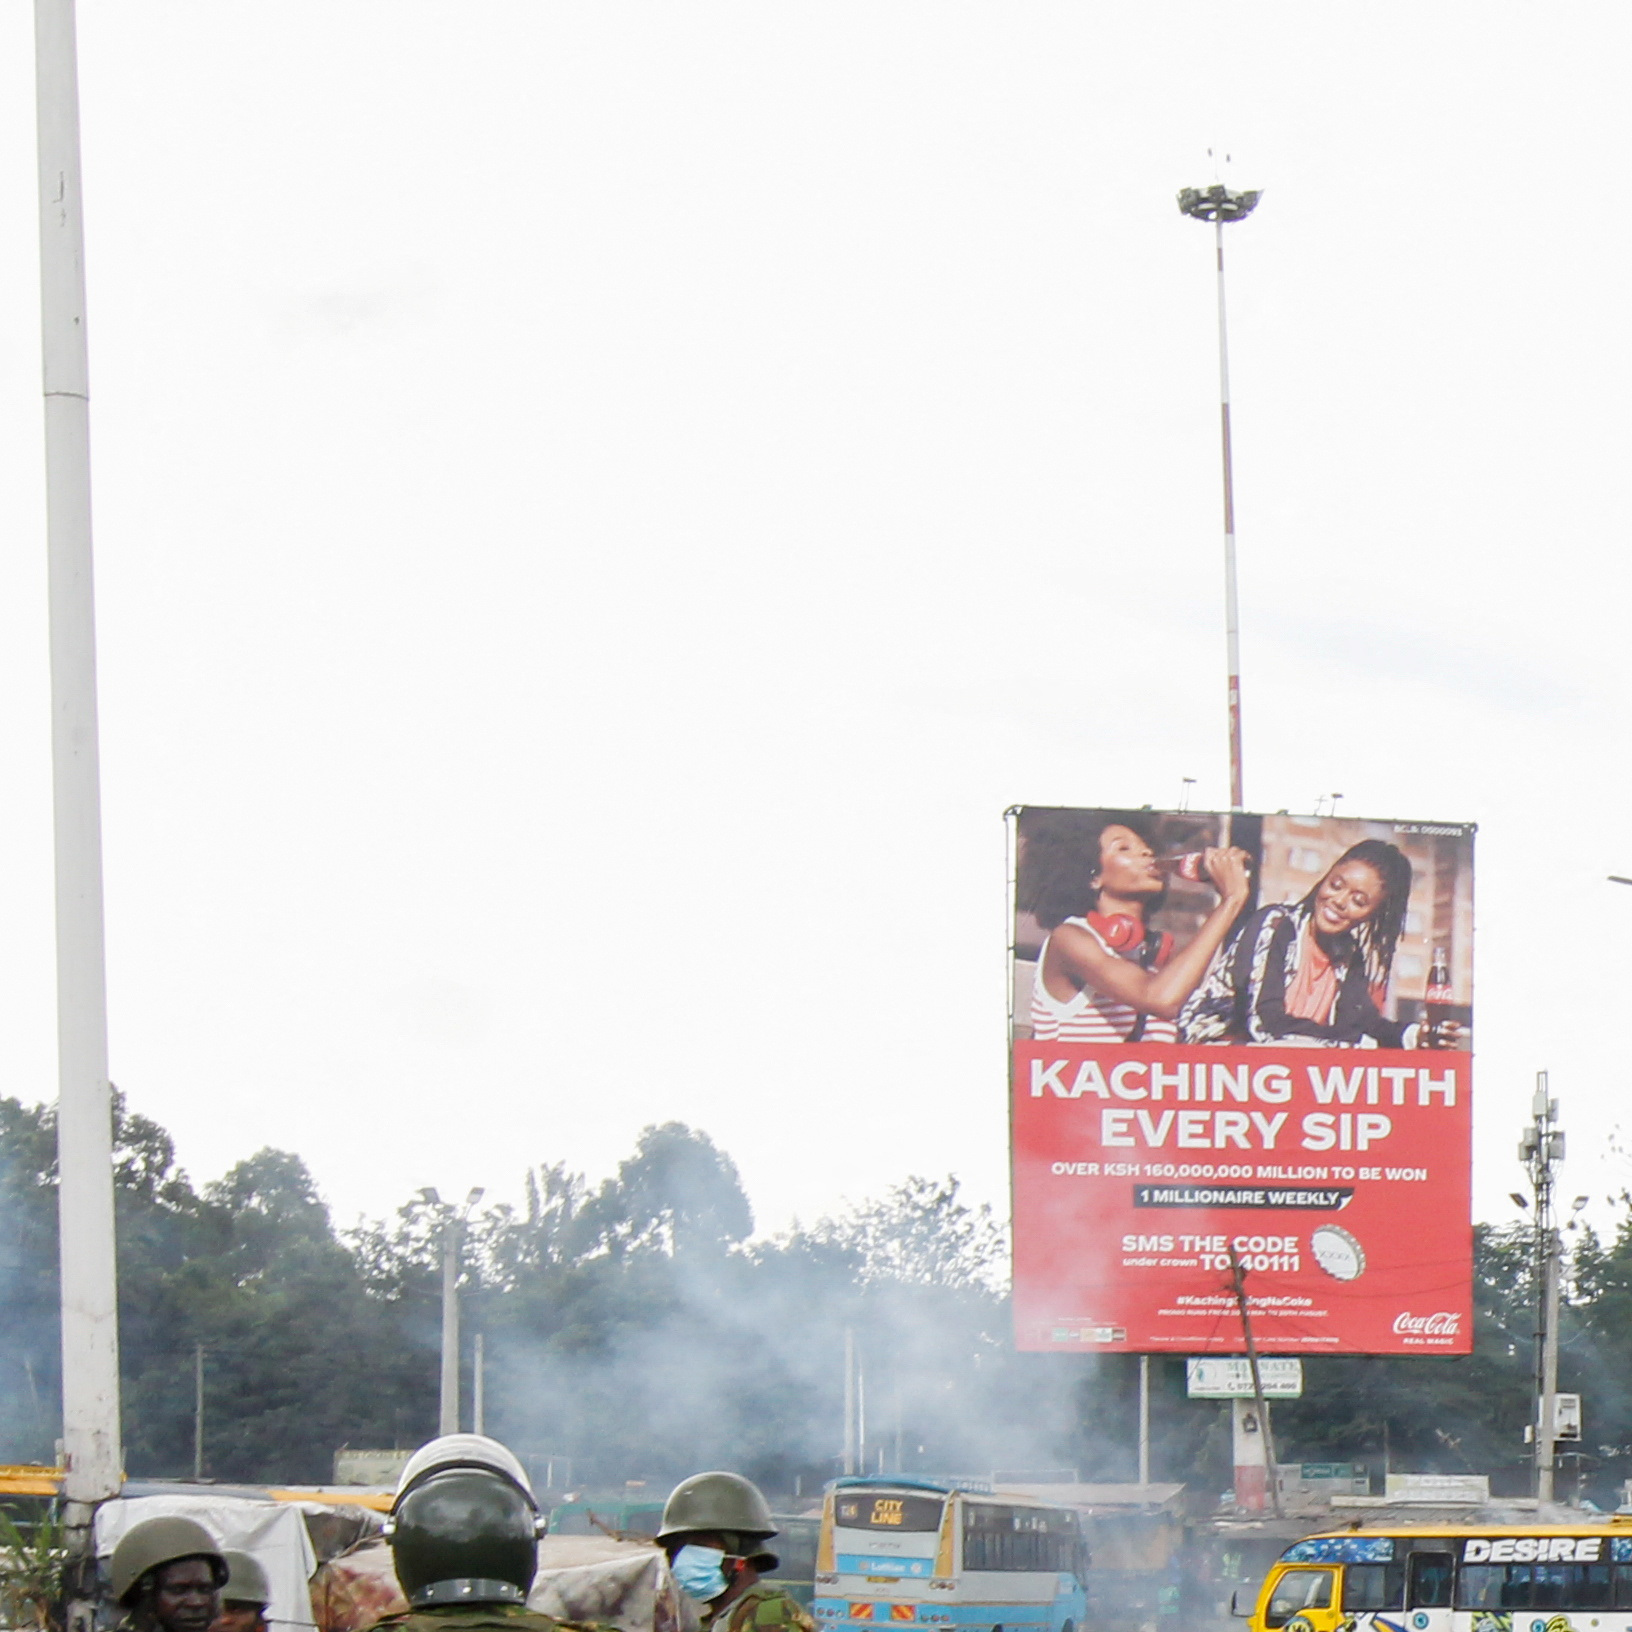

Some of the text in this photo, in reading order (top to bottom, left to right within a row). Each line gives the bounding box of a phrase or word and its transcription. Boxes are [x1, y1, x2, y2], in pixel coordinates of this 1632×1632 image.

[1030, 1058, 1456, 1107] KACHING WITH
[1101, 1108, 1392, 1151] EVERY SIP
[1051, 1162, 1427, 1181] OVER KSH 160,000,000 MILLION TO BE WON
[1140, 1189, 1340, 1206] 1 MILLIONAIRE WEEKLY
[1122, 1234, 1299, 1253] SMS THE CODE
[1122, 1253, 1300, 1272] under crown TO 40111
[1392, 1311, 1462, 1335] Coca-Cola
[875, 1499, 904, 1513] CITY
[870, 1511, 903, 1526] LINE
[1463, 1537, 1602, 1563] DESIRE
